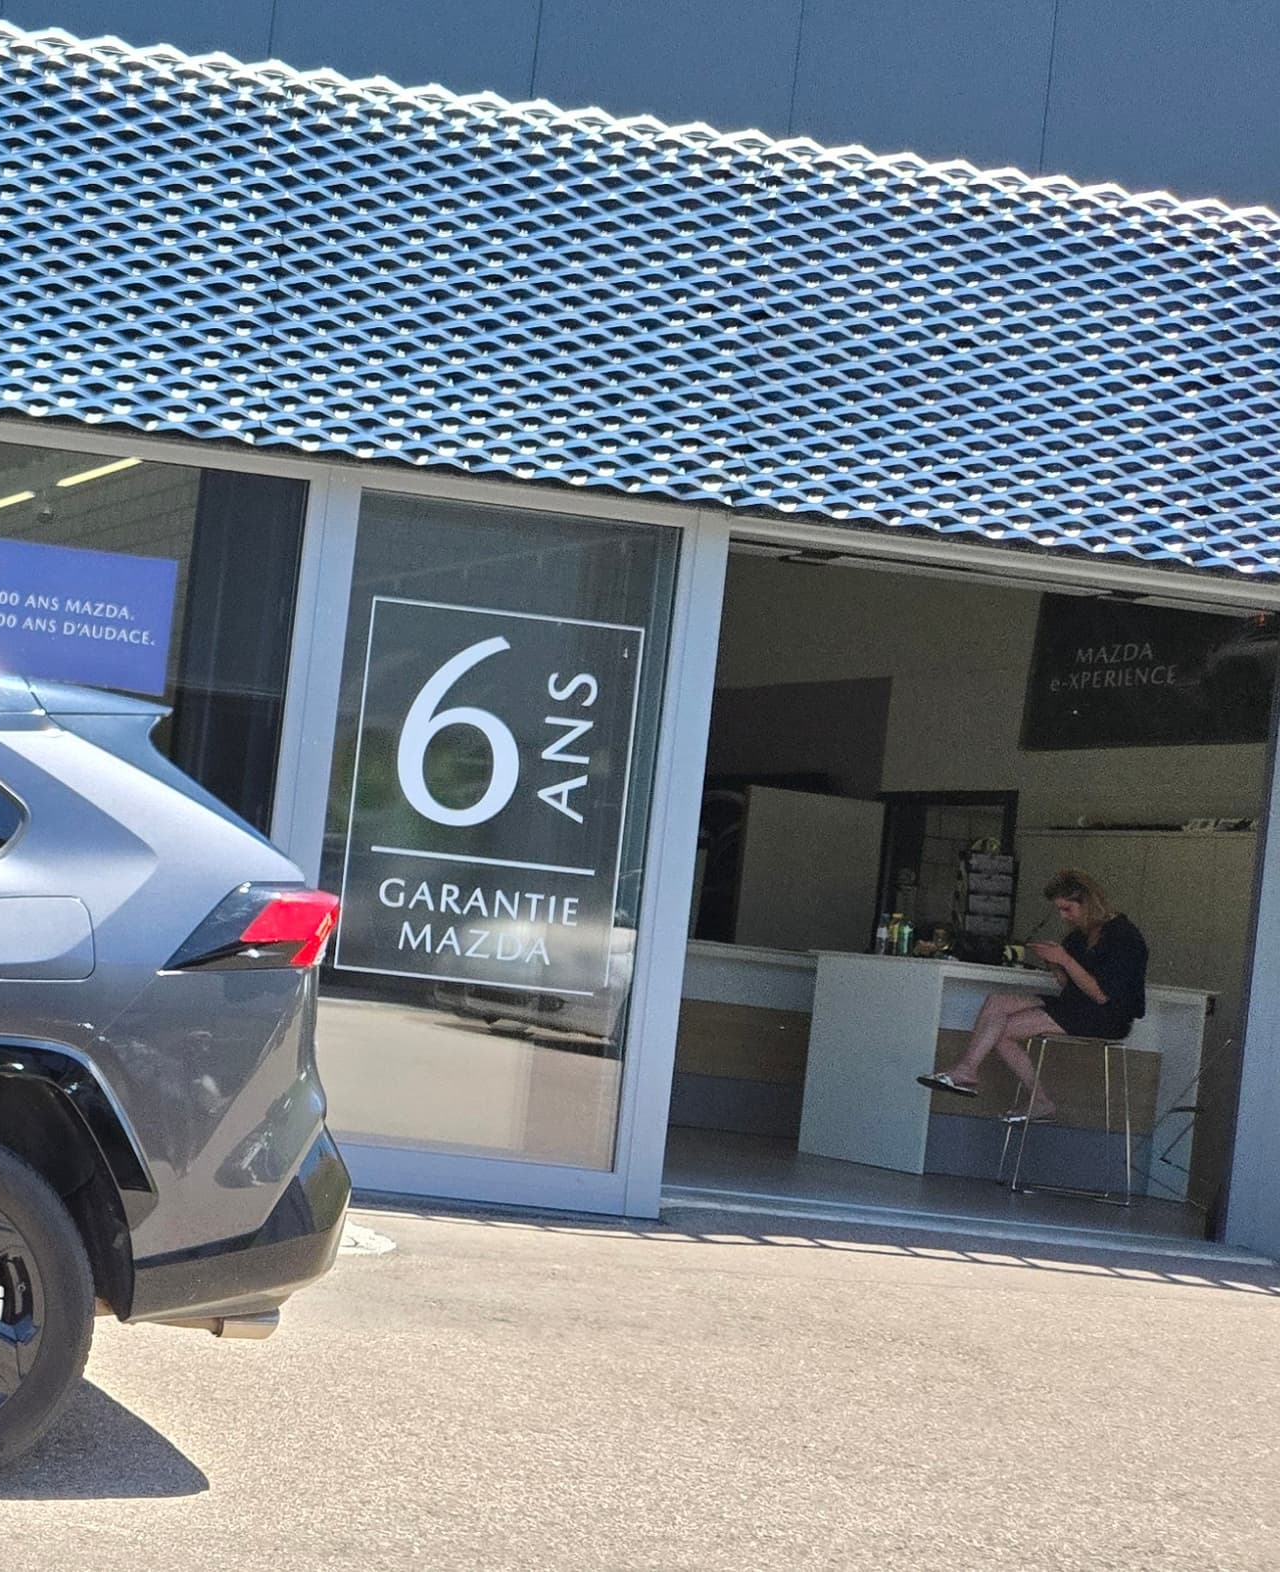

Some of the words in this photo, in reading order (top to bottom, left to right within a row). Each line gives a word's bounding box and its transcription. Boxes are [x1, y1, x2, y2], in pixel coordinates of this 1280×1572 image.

[22, 618, 57, 633] ANS
[25, 595, 59, 611] ANS
[65, 600, 135, 620] MAZDA.
[1075, 643, 1154, 664] MAZDA
[397, 636, 519, 826] 6
[537, 672, 598, 824] ANS
[379, 878, 579, 926] GARANTIE
[398, 921, 550, 965] MAZDA
